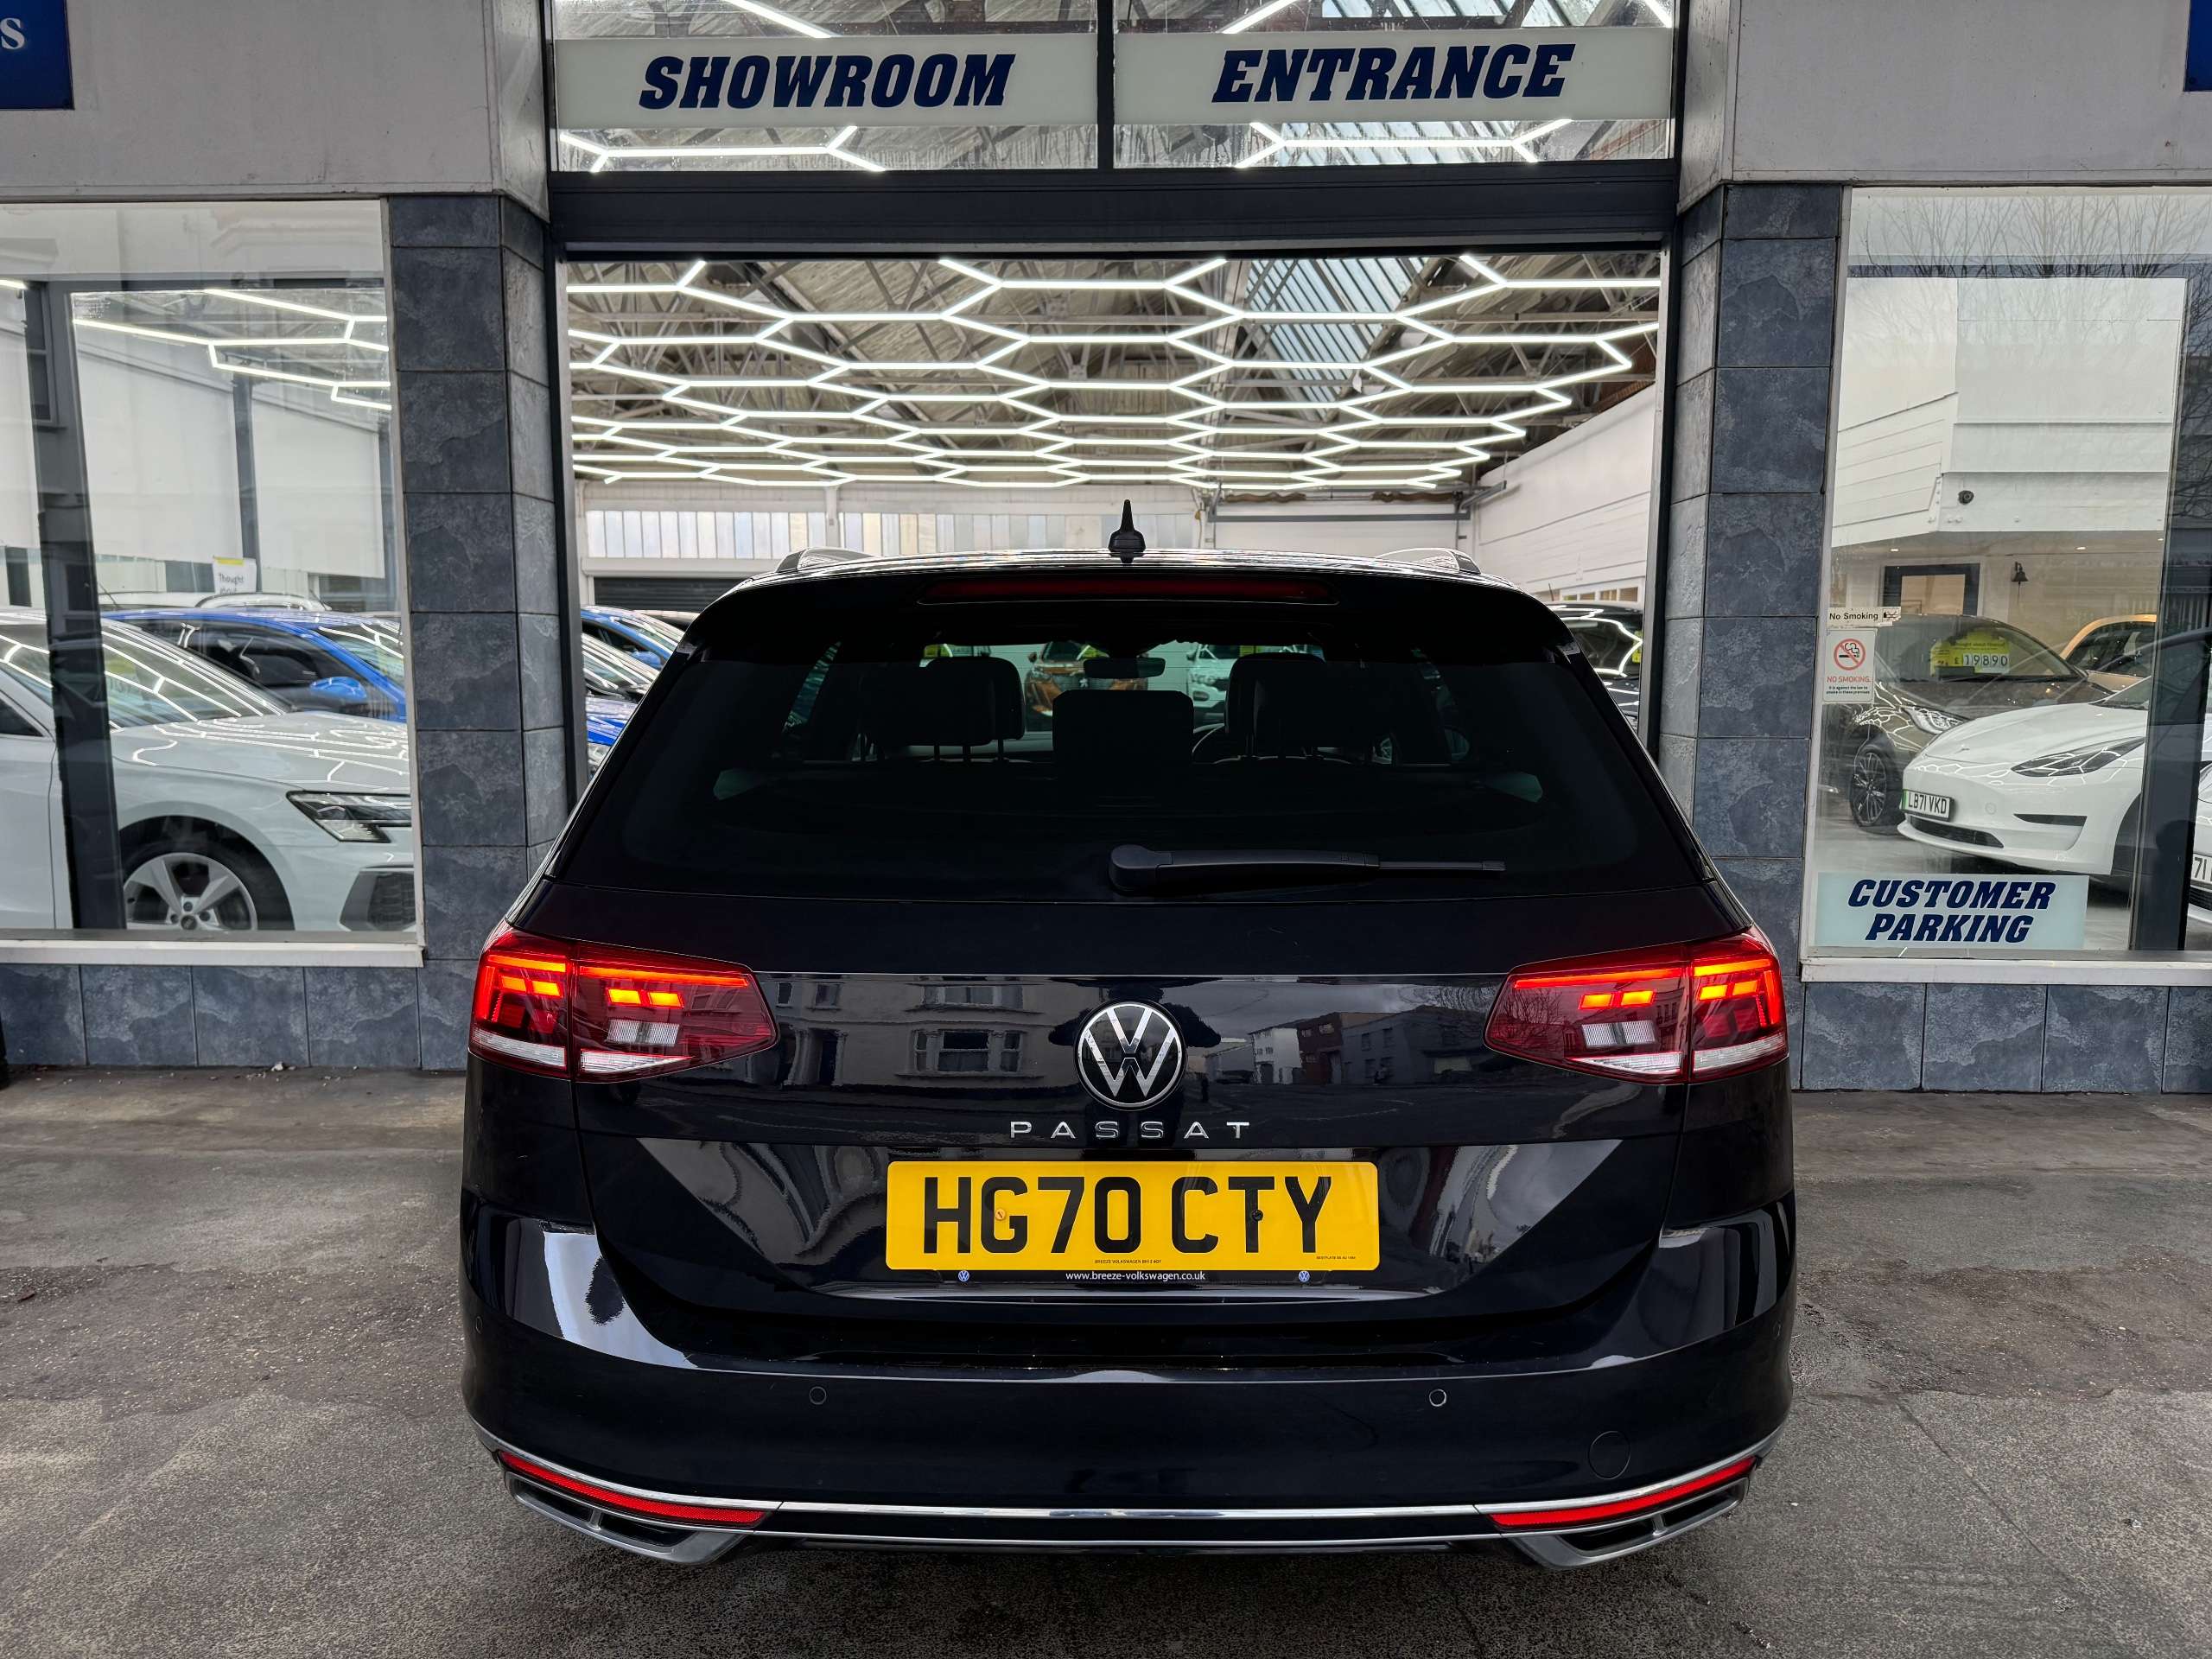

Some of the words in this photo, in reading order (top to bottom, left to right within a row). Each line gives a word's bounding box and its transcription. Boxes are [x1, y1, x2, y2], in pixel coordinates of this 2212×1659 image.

[639, 54, 1016, 110] SHOWROOM
[1211, 43, 1576, 103] ENTRANCE
[1843, 612, 1878, 620] Smoking
[1966, 655, 2008, 667] 19890
[1908, 791, 1927, 811] LB71
[1929, 796, 1947, 814] VKD
[1847, 879, 2056, 910] CUSTOMER
[1865, 912, 2034, 944] PARKING
[1010, 1121, 1250, 1140] PASSAT
[924, 1176, 1142, 1254] HG70
[1171, 1176, 1332, 1254] CTY
[1065, 1270, 1206, 1282] www.breeze-volkswagen.co.uk
